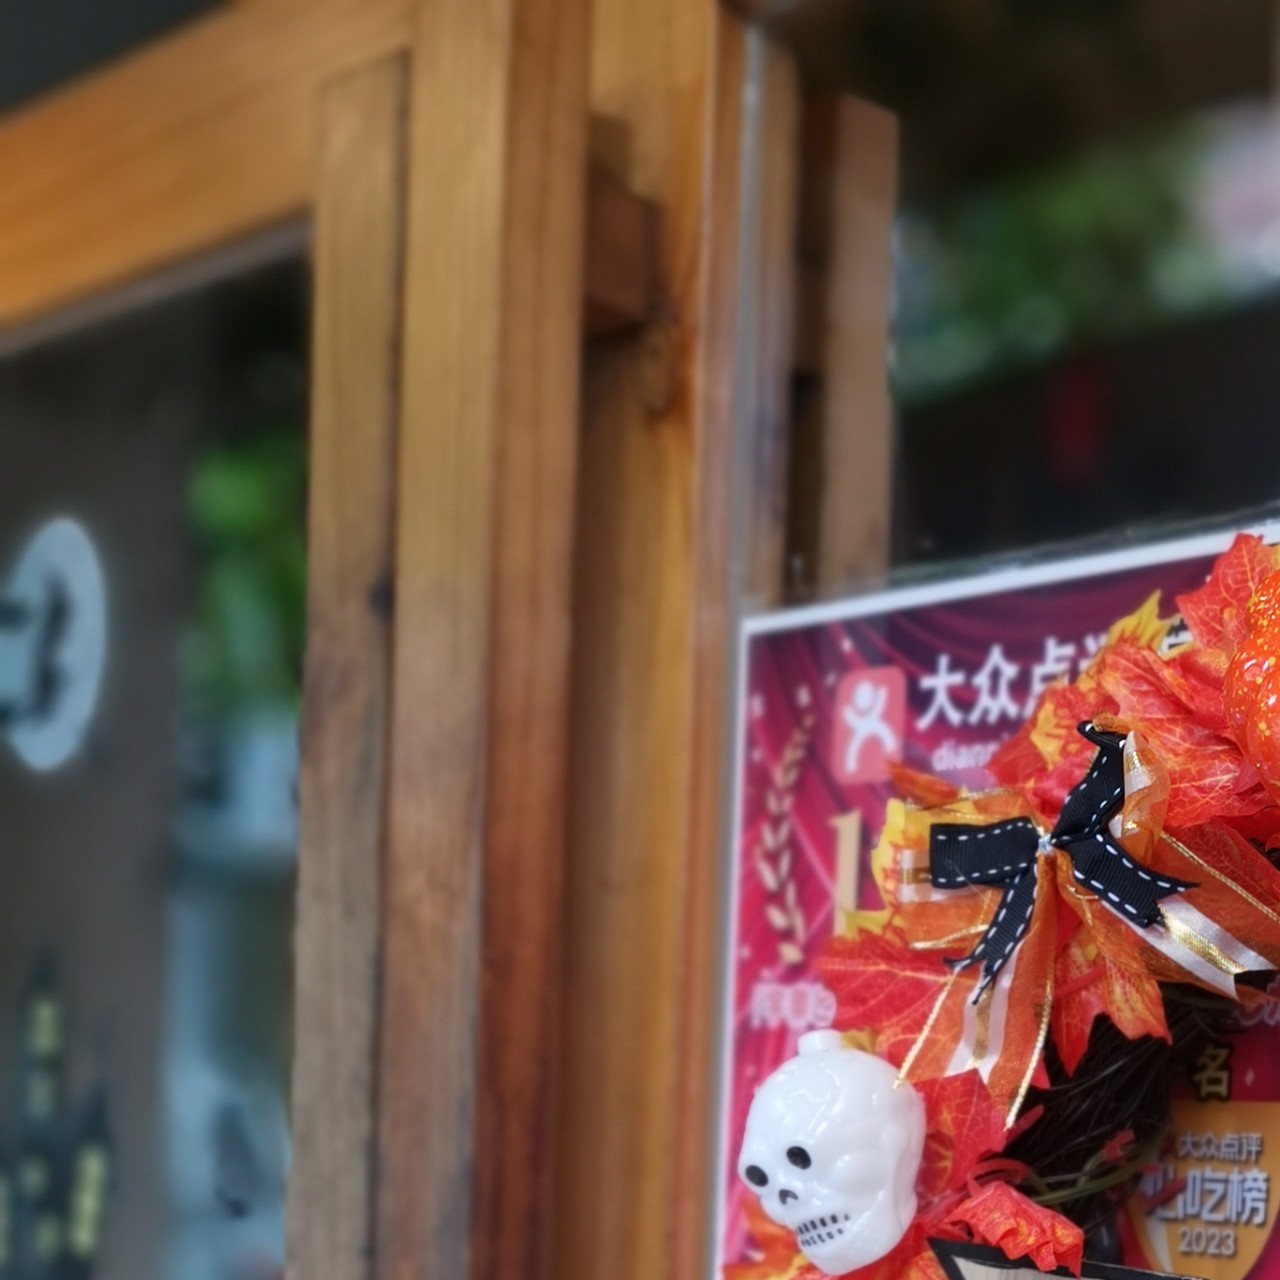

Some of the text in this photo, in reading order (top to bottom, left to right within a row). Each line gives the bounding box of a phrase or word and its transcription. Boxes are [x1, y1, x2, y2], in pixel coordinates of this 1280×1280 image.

[914, 635, 1108, 731] 大众点
[1178, 1132, 1263, 1162] 大众点评
[1178, 1226, 1236, 1257] 2023
